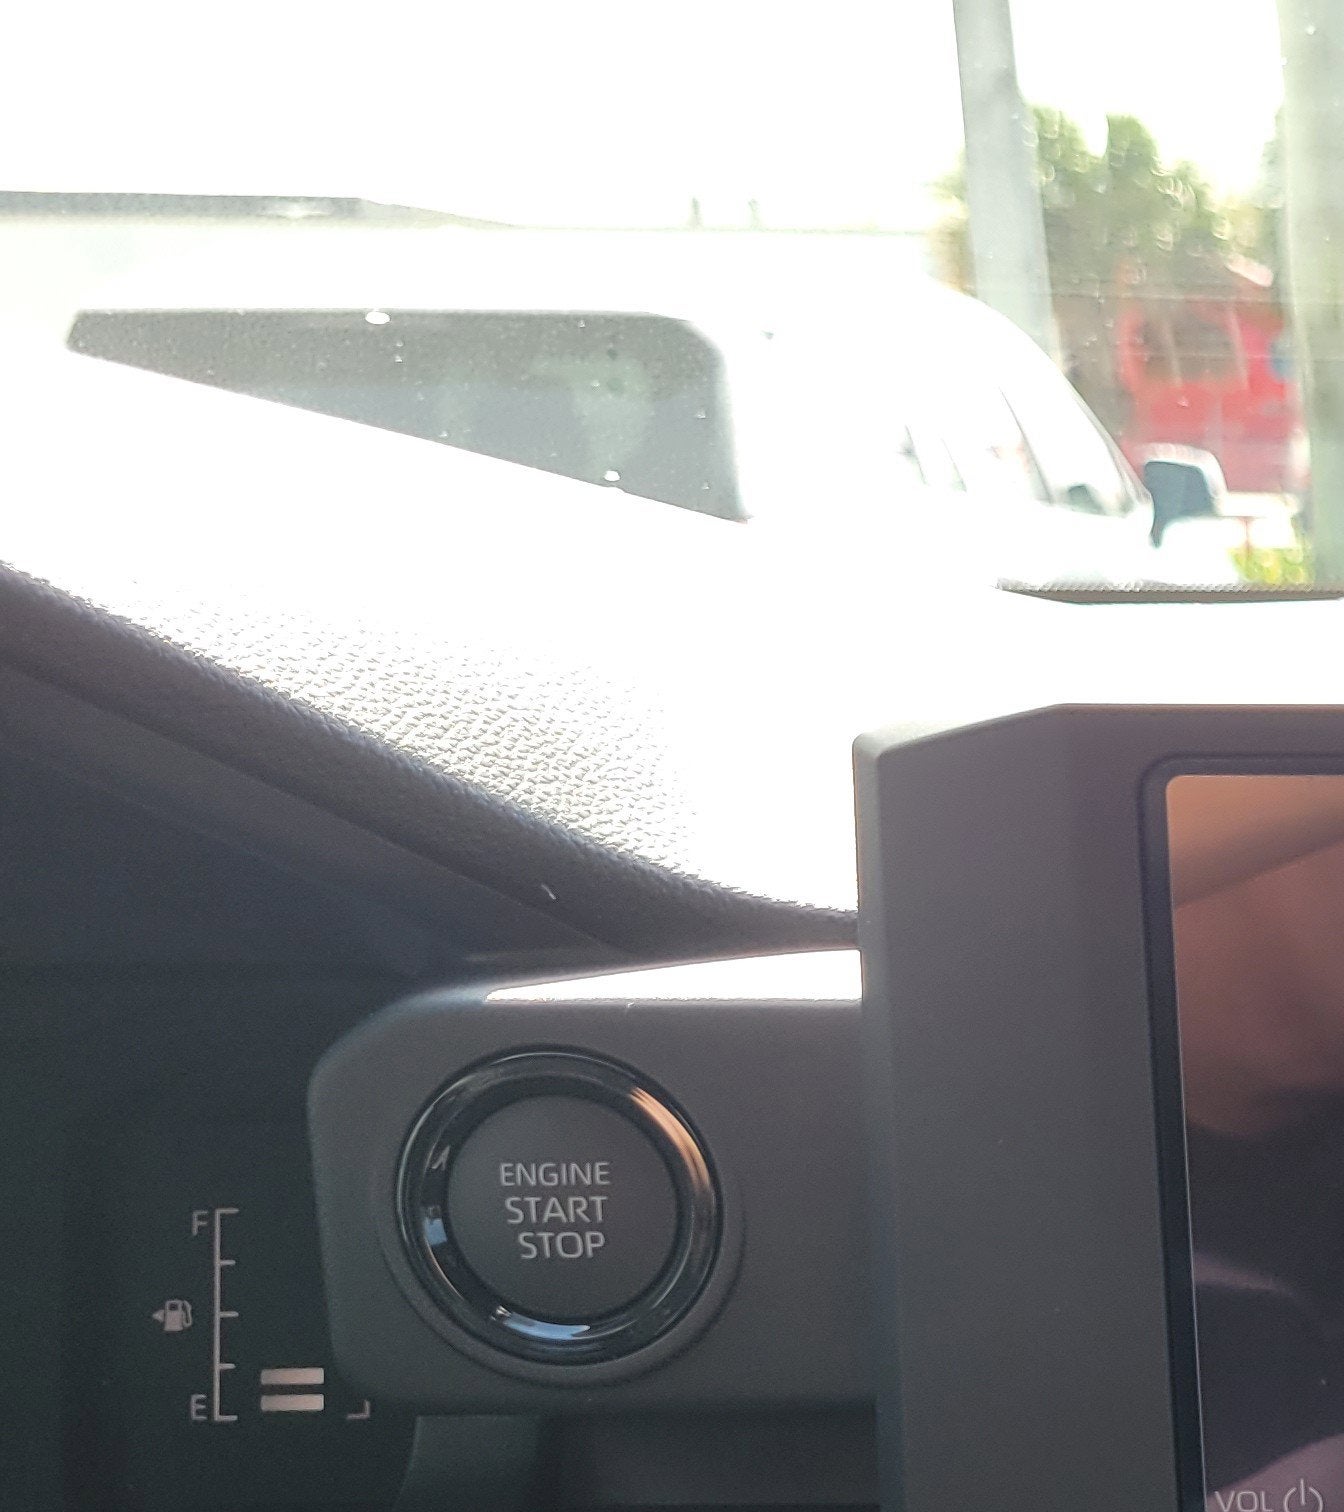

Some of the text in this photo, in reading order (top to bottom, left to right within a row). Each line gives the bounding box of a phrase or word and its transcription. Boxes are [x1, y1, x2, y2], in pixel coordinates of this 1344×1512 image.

[500, 1161, 611, 1188] ENGINE
[192, 1210, 209, 1237] F
[503, 1196, 609, 1225] START
[518, 1231, 606, 1260] STOP
[190, 1393, 208, 1421] E
